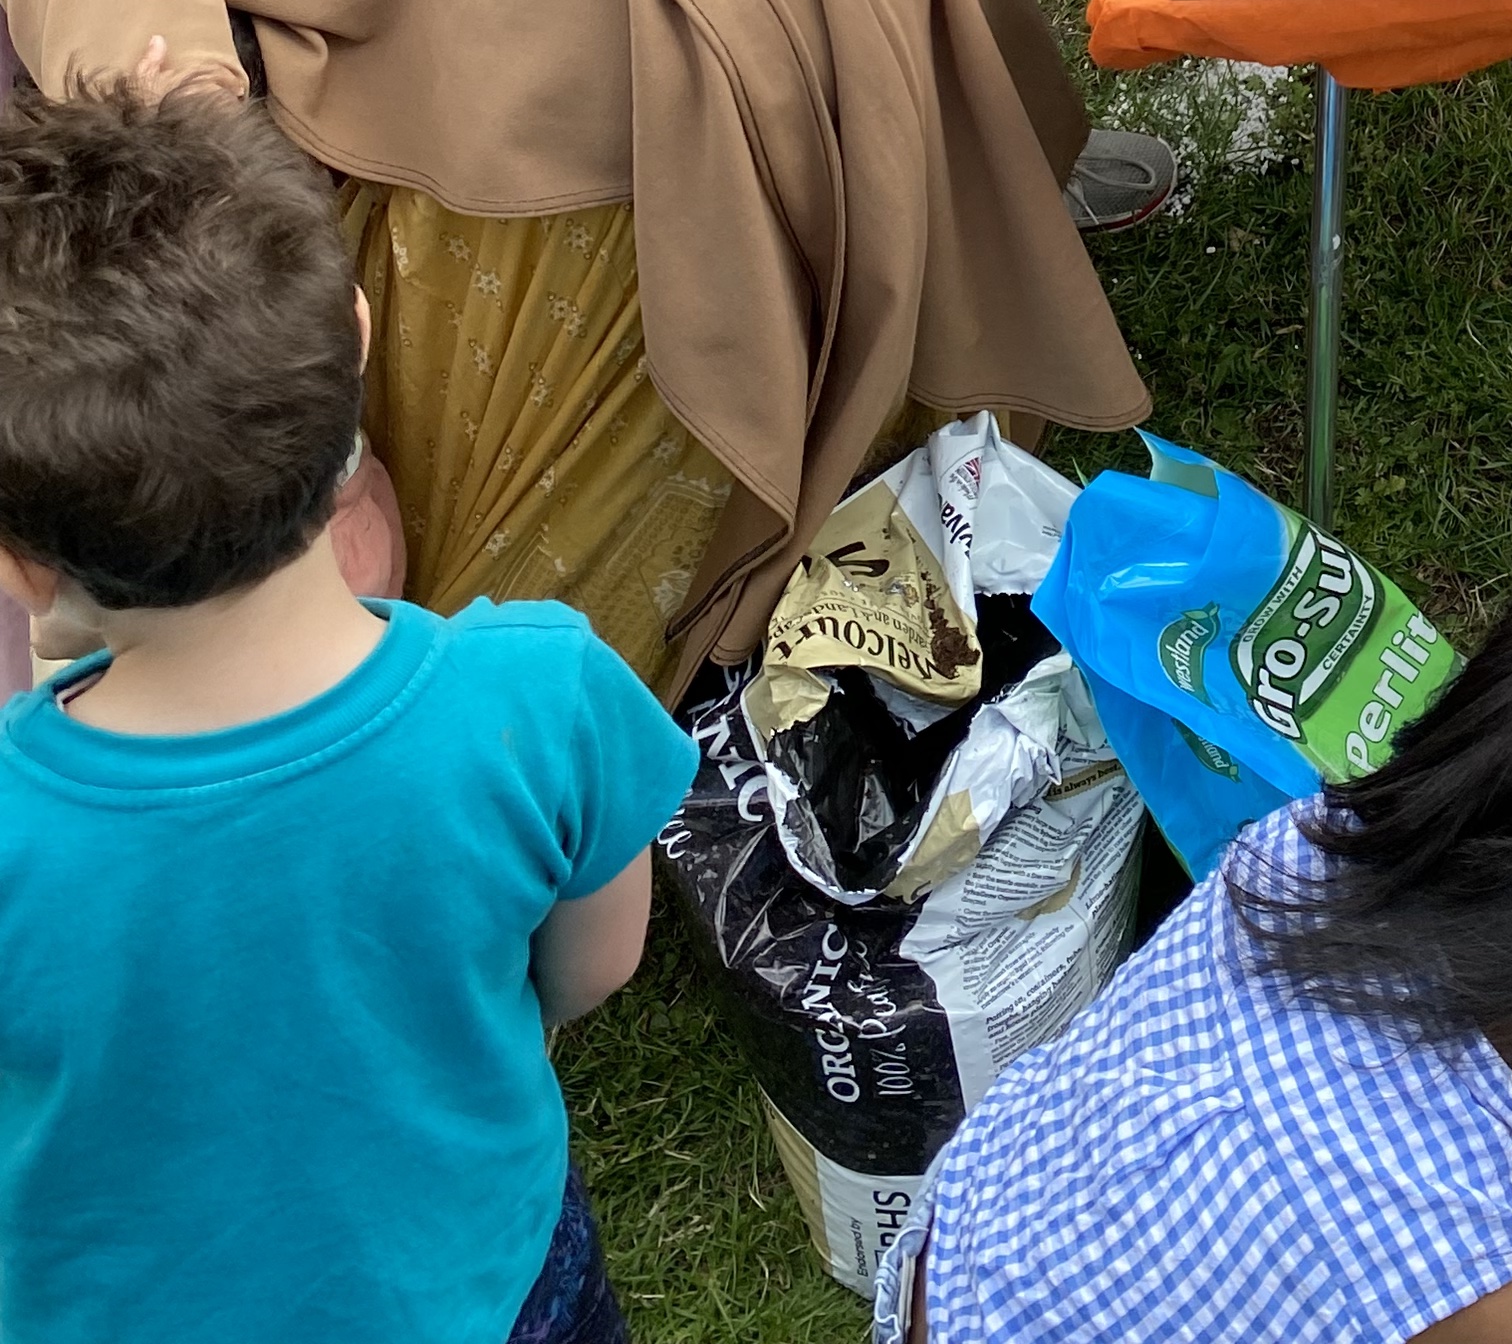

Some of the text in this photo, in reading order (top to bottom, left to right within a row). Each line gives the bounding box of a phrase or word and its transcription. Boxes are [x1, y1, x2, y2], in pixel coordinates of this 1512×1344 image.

[893, 619, 932, 654] arden
[1243, 566, 1304, 643] GROW WITH
[1322, 594, 1373, 671] CERTAINTY
[771, 614, 960, 681] Melcourt
[1053, 785, 1062, 796] is
[1064, 774, 1097, 793] always
[800, 922, 861, 1103] ORGANIC
[870, 1042, 915, 1096] 100%
[850, 1216, 869, 1278] Endorsed by
